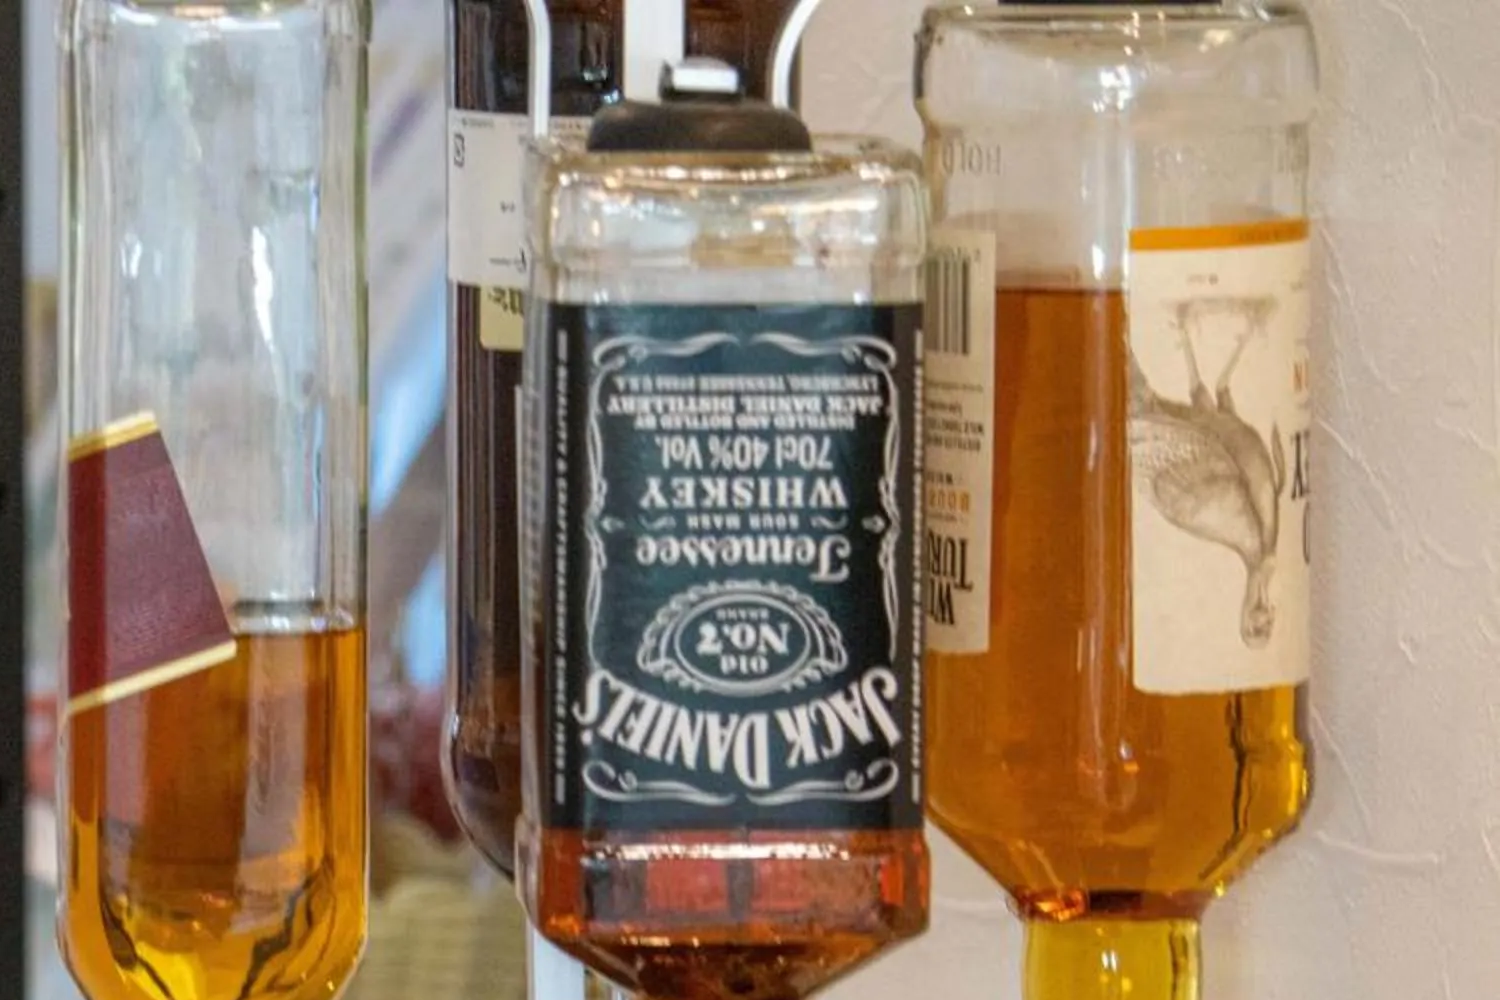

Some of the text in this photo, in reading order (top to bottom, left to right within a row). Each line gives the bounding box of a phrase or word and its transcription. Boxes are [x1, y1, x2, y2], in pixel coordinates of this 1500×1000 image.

[607, 395, 883, 415] JACK DANIEL DISTILLERY
[660, 413, 734, 431] BOTTLED
[736, 413, 771, 431] AND
[654, 434, 834, 470] 70cl 40% Vol.
[639, 475, 848, 509] WHISKEY
[686, 514, 800, 531] SOUR MASH
[636, 534, 851, 583] Tennessee
[696, 621, 792, 656] No.7
[720, 654, 769, 675] Old
[571, 666, 902, 789] JACK DANIEL'S
